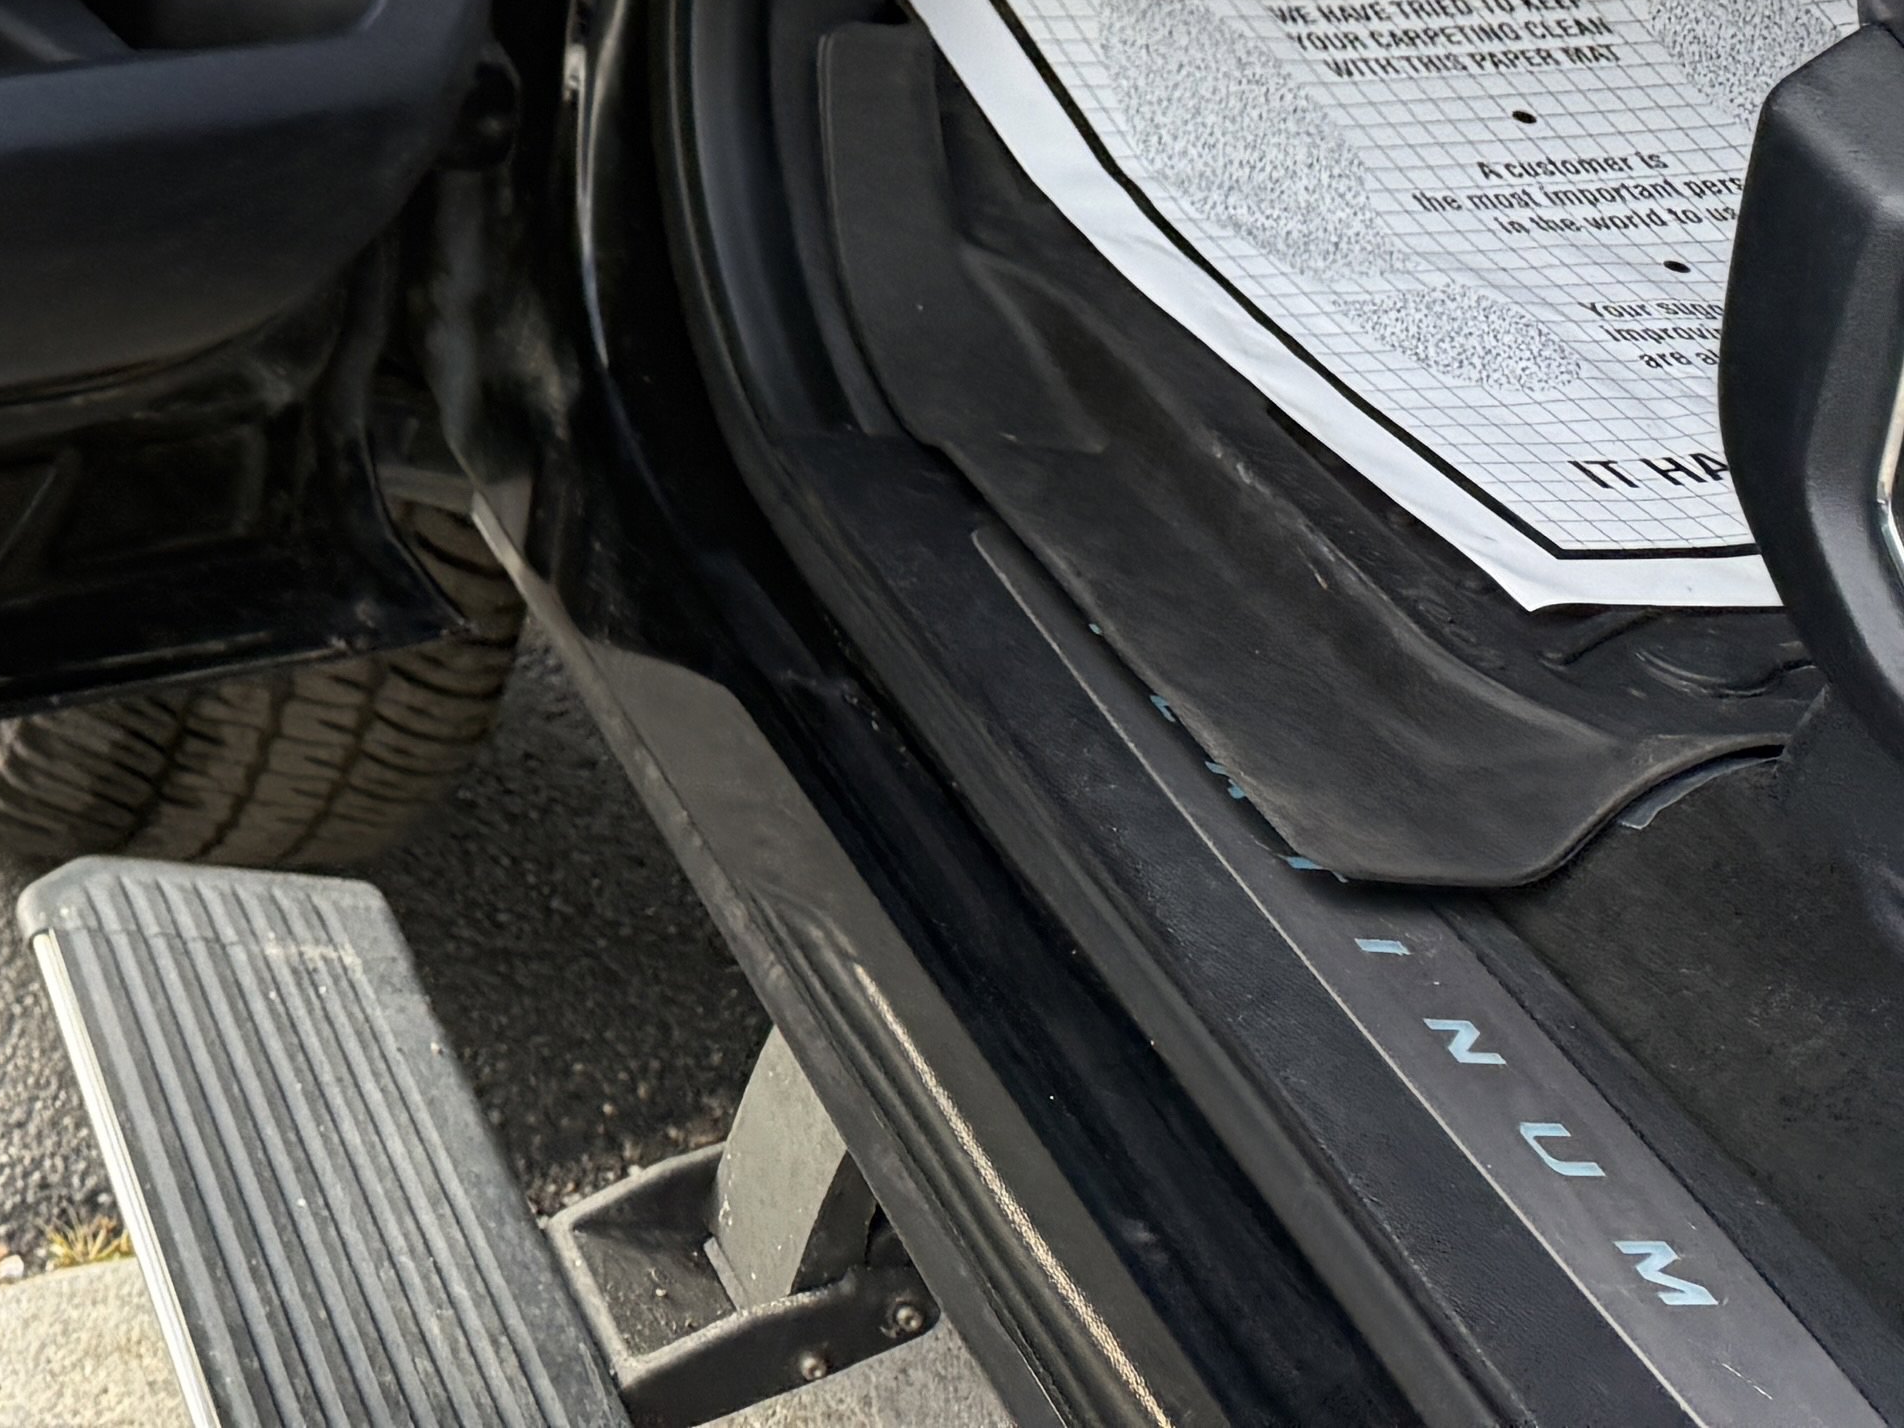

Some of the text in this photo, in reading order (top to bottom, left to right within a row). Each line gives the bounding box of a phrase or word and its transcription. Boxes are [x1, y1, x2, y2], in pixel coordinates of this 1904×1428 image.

[1266, 3, 1318, 26] WE
[1316, 0, 1391, 25] HAVE
[1287, 15, 1616, 53] YOUR CARPETING CLEAN
[1323, 43, 1623, 79] WITH THIS PAPER MAT
[1476, 150, 1670, 181] A customer is
[1411, 190, 1462, 213] the
[1466, 186, 1540, 211] most
[1539, 178, 1678, 209] important
[1493, 206, 1736, 236] in the world to us
[1577, 301, 1653, 319] Your
[1639, 350, 1692, 370] are
[1567, 459, 1639, 489] IT
